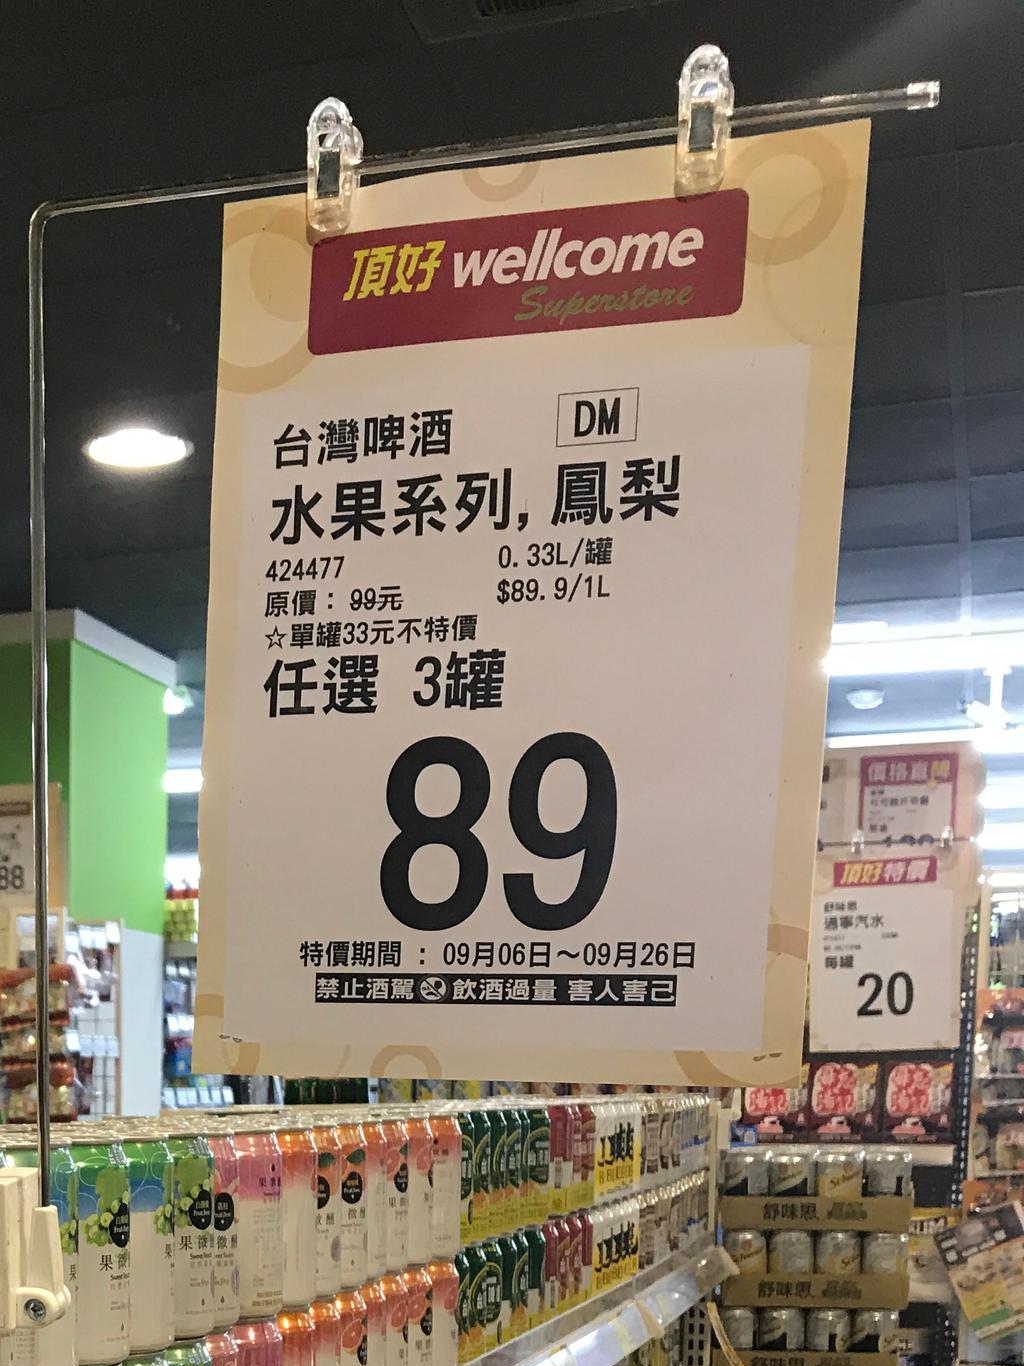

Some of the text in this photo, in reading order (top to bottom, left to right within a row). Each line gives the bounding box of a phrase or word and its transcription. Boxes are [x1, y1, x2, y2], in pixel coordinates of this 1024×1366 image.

[344, 224, 705, 301] 頂好 wellcome
[514, 282, 694, 324] Superstore
[274, 397, 621, 469] 台灣啤酒 DM
[266, 558, 344, 581] 424477
[264, 649, 506, 718] 任選 3罐
[379, 731, 618, 932] 89
[316, 976, 676, 1003] 禁止酒駕 飲酒過量 害人害己
[857, 971, 914, 1017] 20
